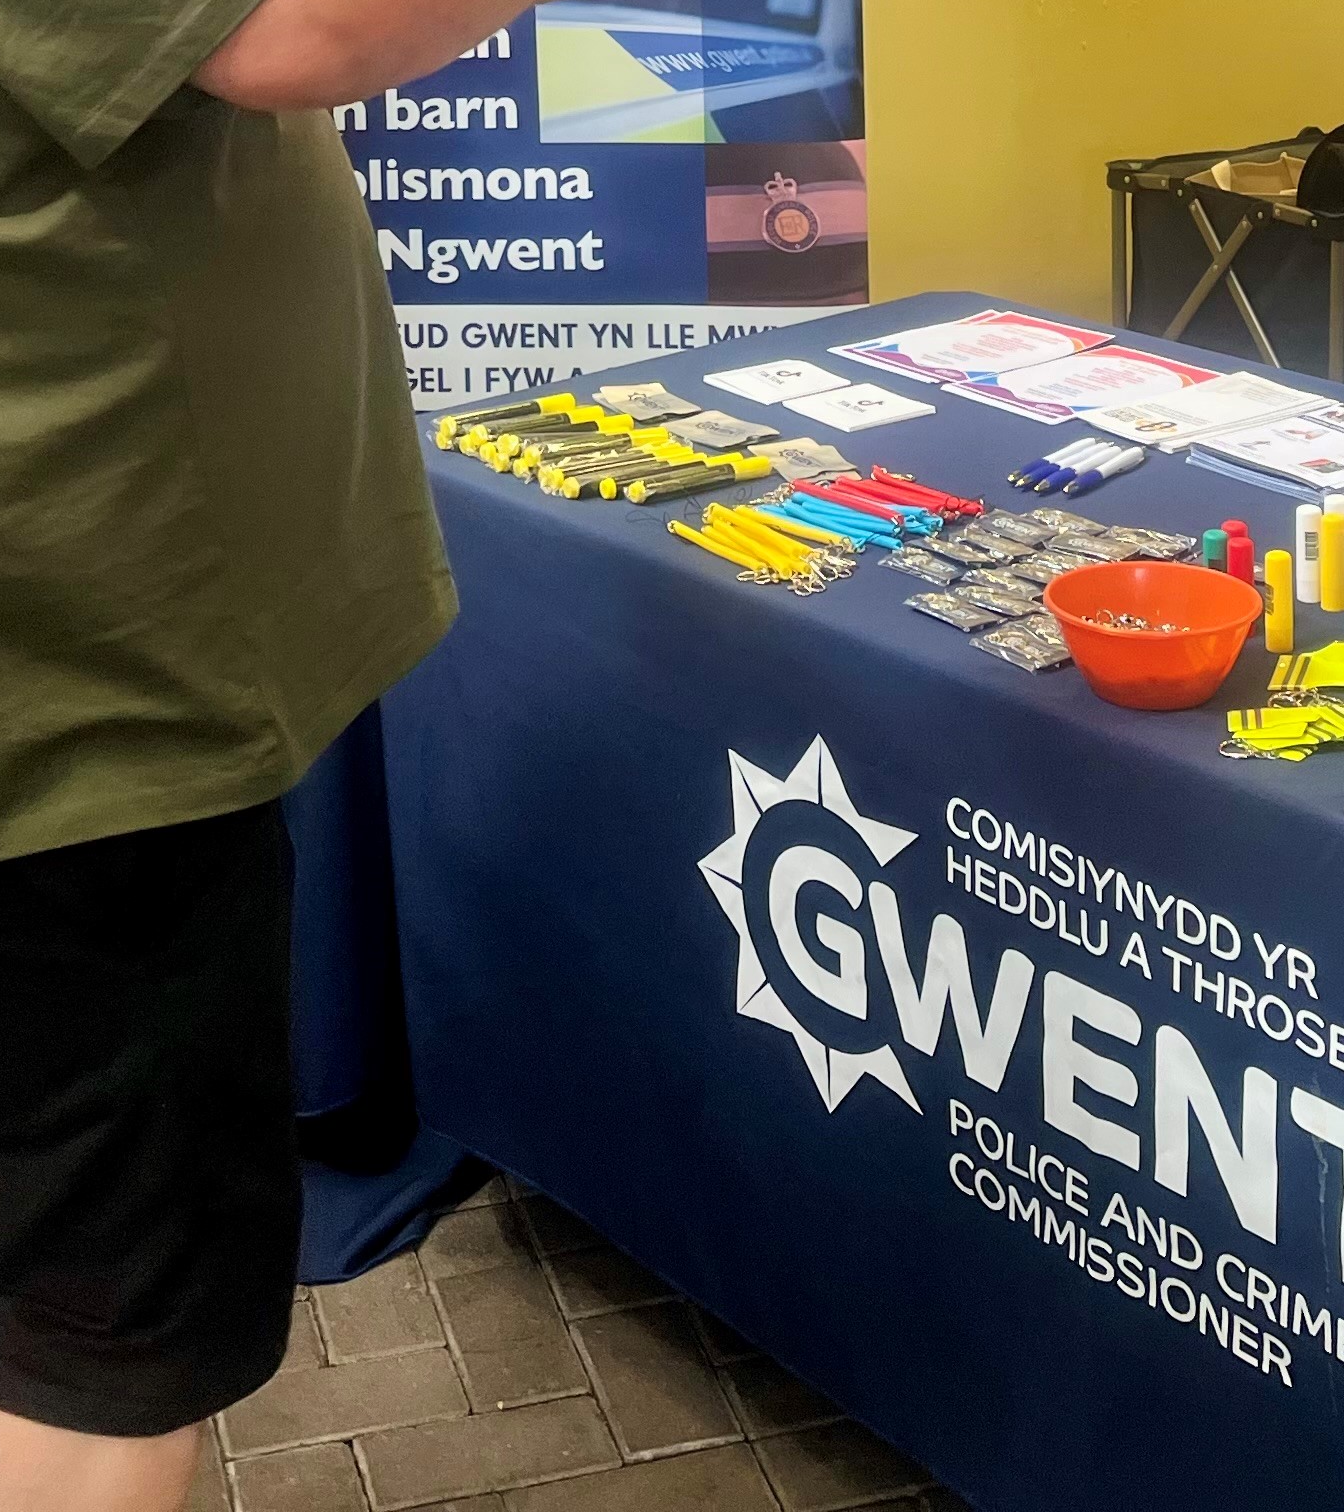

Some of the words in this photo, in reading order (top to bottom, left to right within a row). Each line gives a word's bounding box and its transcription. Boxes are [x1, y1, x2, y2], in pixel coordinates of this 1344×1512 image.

[385, 88, 518, 131] barn
[382, 228, 605, 285] Ngwent
[397, 323, 449, 349] UD
[461, 323, 578, 349] GWENT
[588, 323, 633, 348] YN
[647, 323, 695, 349] LLE
[465, 368, 471, 392] I
[486, 367, 555, 393] FYW
[946, 796, 1242, 964] COMISIYNYDD
[1253, 932, 1320, 1001] YR
[946, 844, 1110, 959] HEDDLU
[1119, 930, 1153, 981] A
[948, 1097, 1090, 1210] POLICE
[1100, 1191, 1203, 1273] AND
[948, 1151, 1294, 1389] COMMISSIONER
